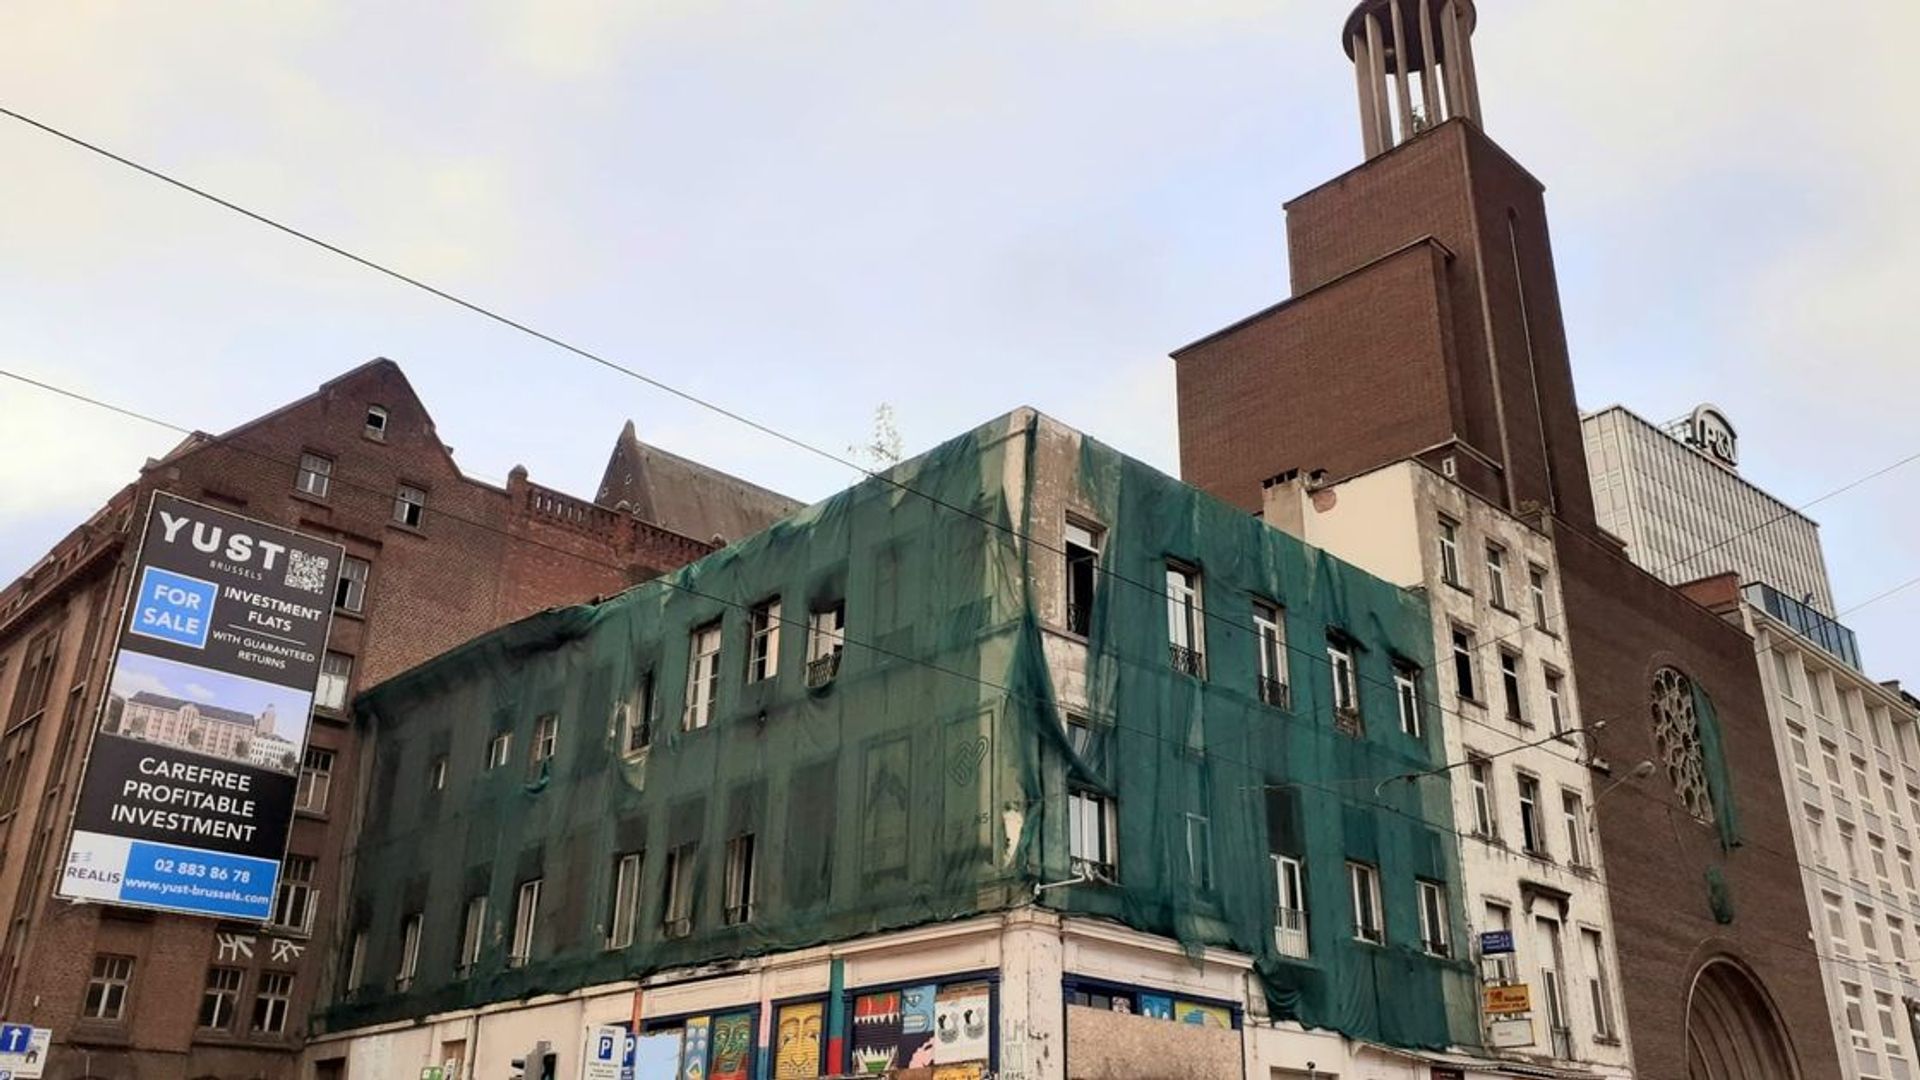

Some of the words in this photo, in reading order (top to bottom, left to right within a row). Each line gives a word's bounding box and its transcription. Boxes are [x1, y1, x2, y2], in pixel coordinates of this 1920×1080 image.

[160, 510, 285, 571] YUST
[208, 560, 263, 581] BRUSSELS
[153, 584, 202, 610] FOR
[224, 586, 322, 621] INVESTMENT
[143, 606, 200, 635] SALE
[247, 610, 293, 632] FLATS
[212, 630, 241, 644] WITH
[243, 637, 315, 662] GUARANTEED
[237, 649, 286, 669] RETURNS
[139, 757, 252, 793] CAREFREE
[123, 779, 256, 818] PROFITABLE
[111, 803, 257, 843] INVESTMENT
[66, 866, 122, 884] REALIS
[154, 857, 174, 874] 02
[177, 862, 206, 878] 883
[209, 866, 228, 881] 86
[232, 869, 250, 884] 78
[125, 877, 269, 904] www.yust-brussels.com
